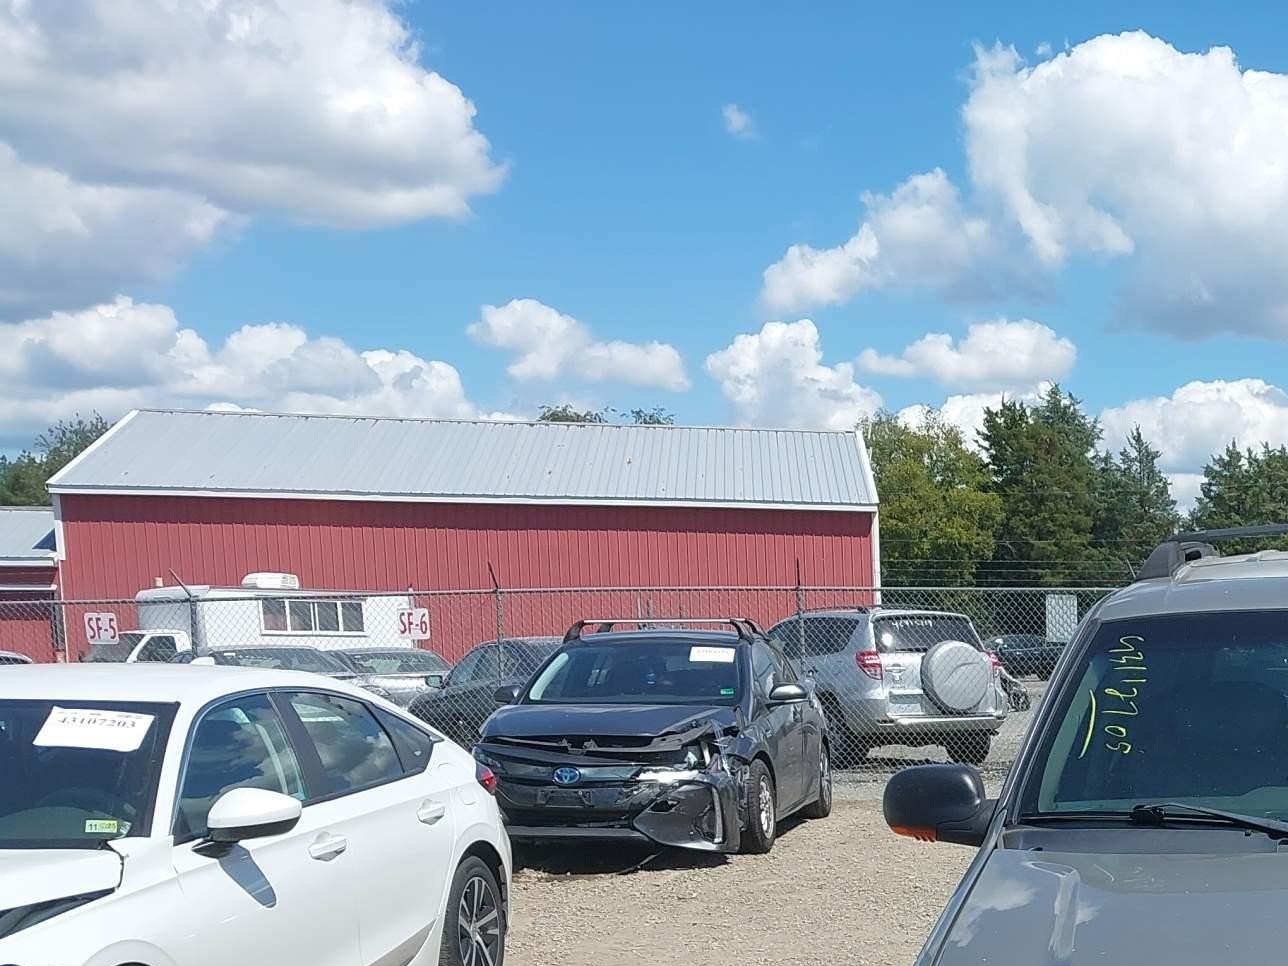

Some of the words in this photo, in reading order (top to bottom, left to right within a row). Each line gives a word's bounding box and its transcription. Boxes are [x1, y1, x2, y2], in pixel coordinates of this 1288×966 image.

[87, 617, 116, 639] SF-5
[399, 612, 427, 634] SF-6
[1101, 635, 1147, 754] 43112705
